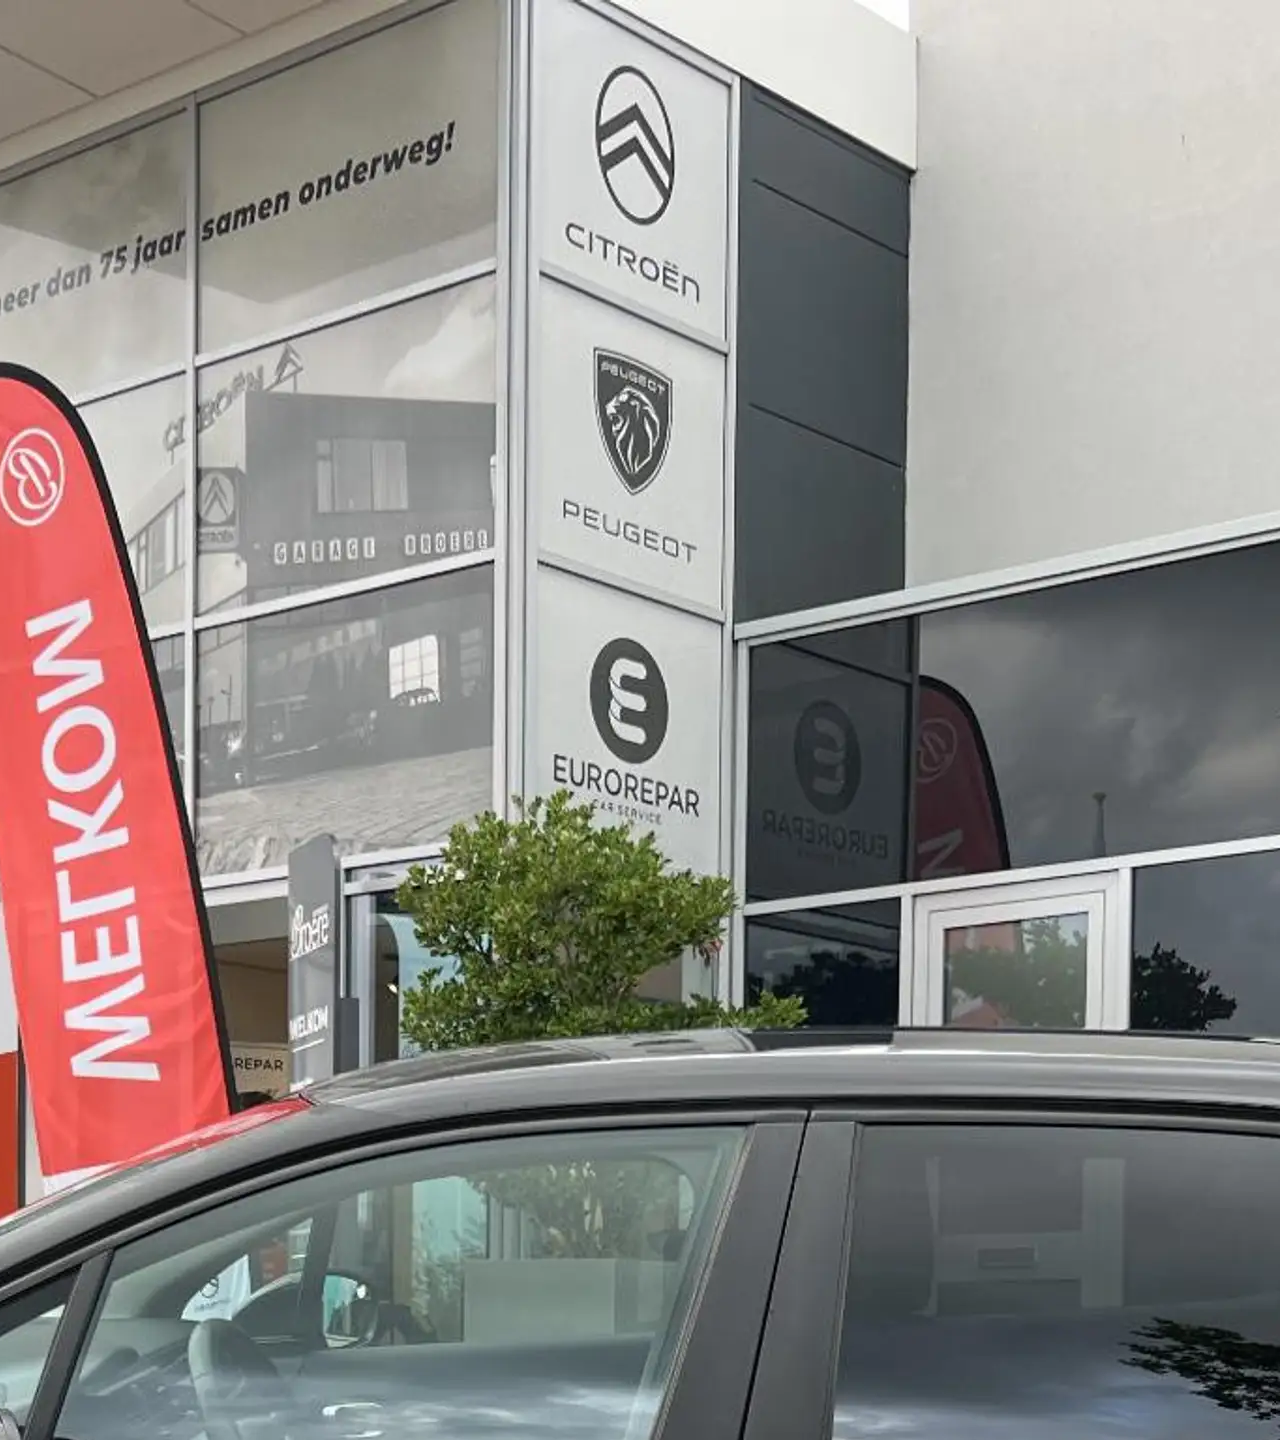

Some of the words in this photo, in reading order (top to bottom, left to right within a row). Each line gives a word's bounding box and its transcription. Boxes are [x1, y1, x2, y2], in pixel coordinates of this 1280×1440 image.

[46, 261, 93, 298] dan
[99, 249, 127, 279] 75
[130, 228, 186, 277] jaar
[201, 191, 290, 242] samen
[299, 121, 457, 206] onderweg!
[563, 498, 697, 564] PEUGEOT
[552, 753, 700, 818] EUROREPAR
